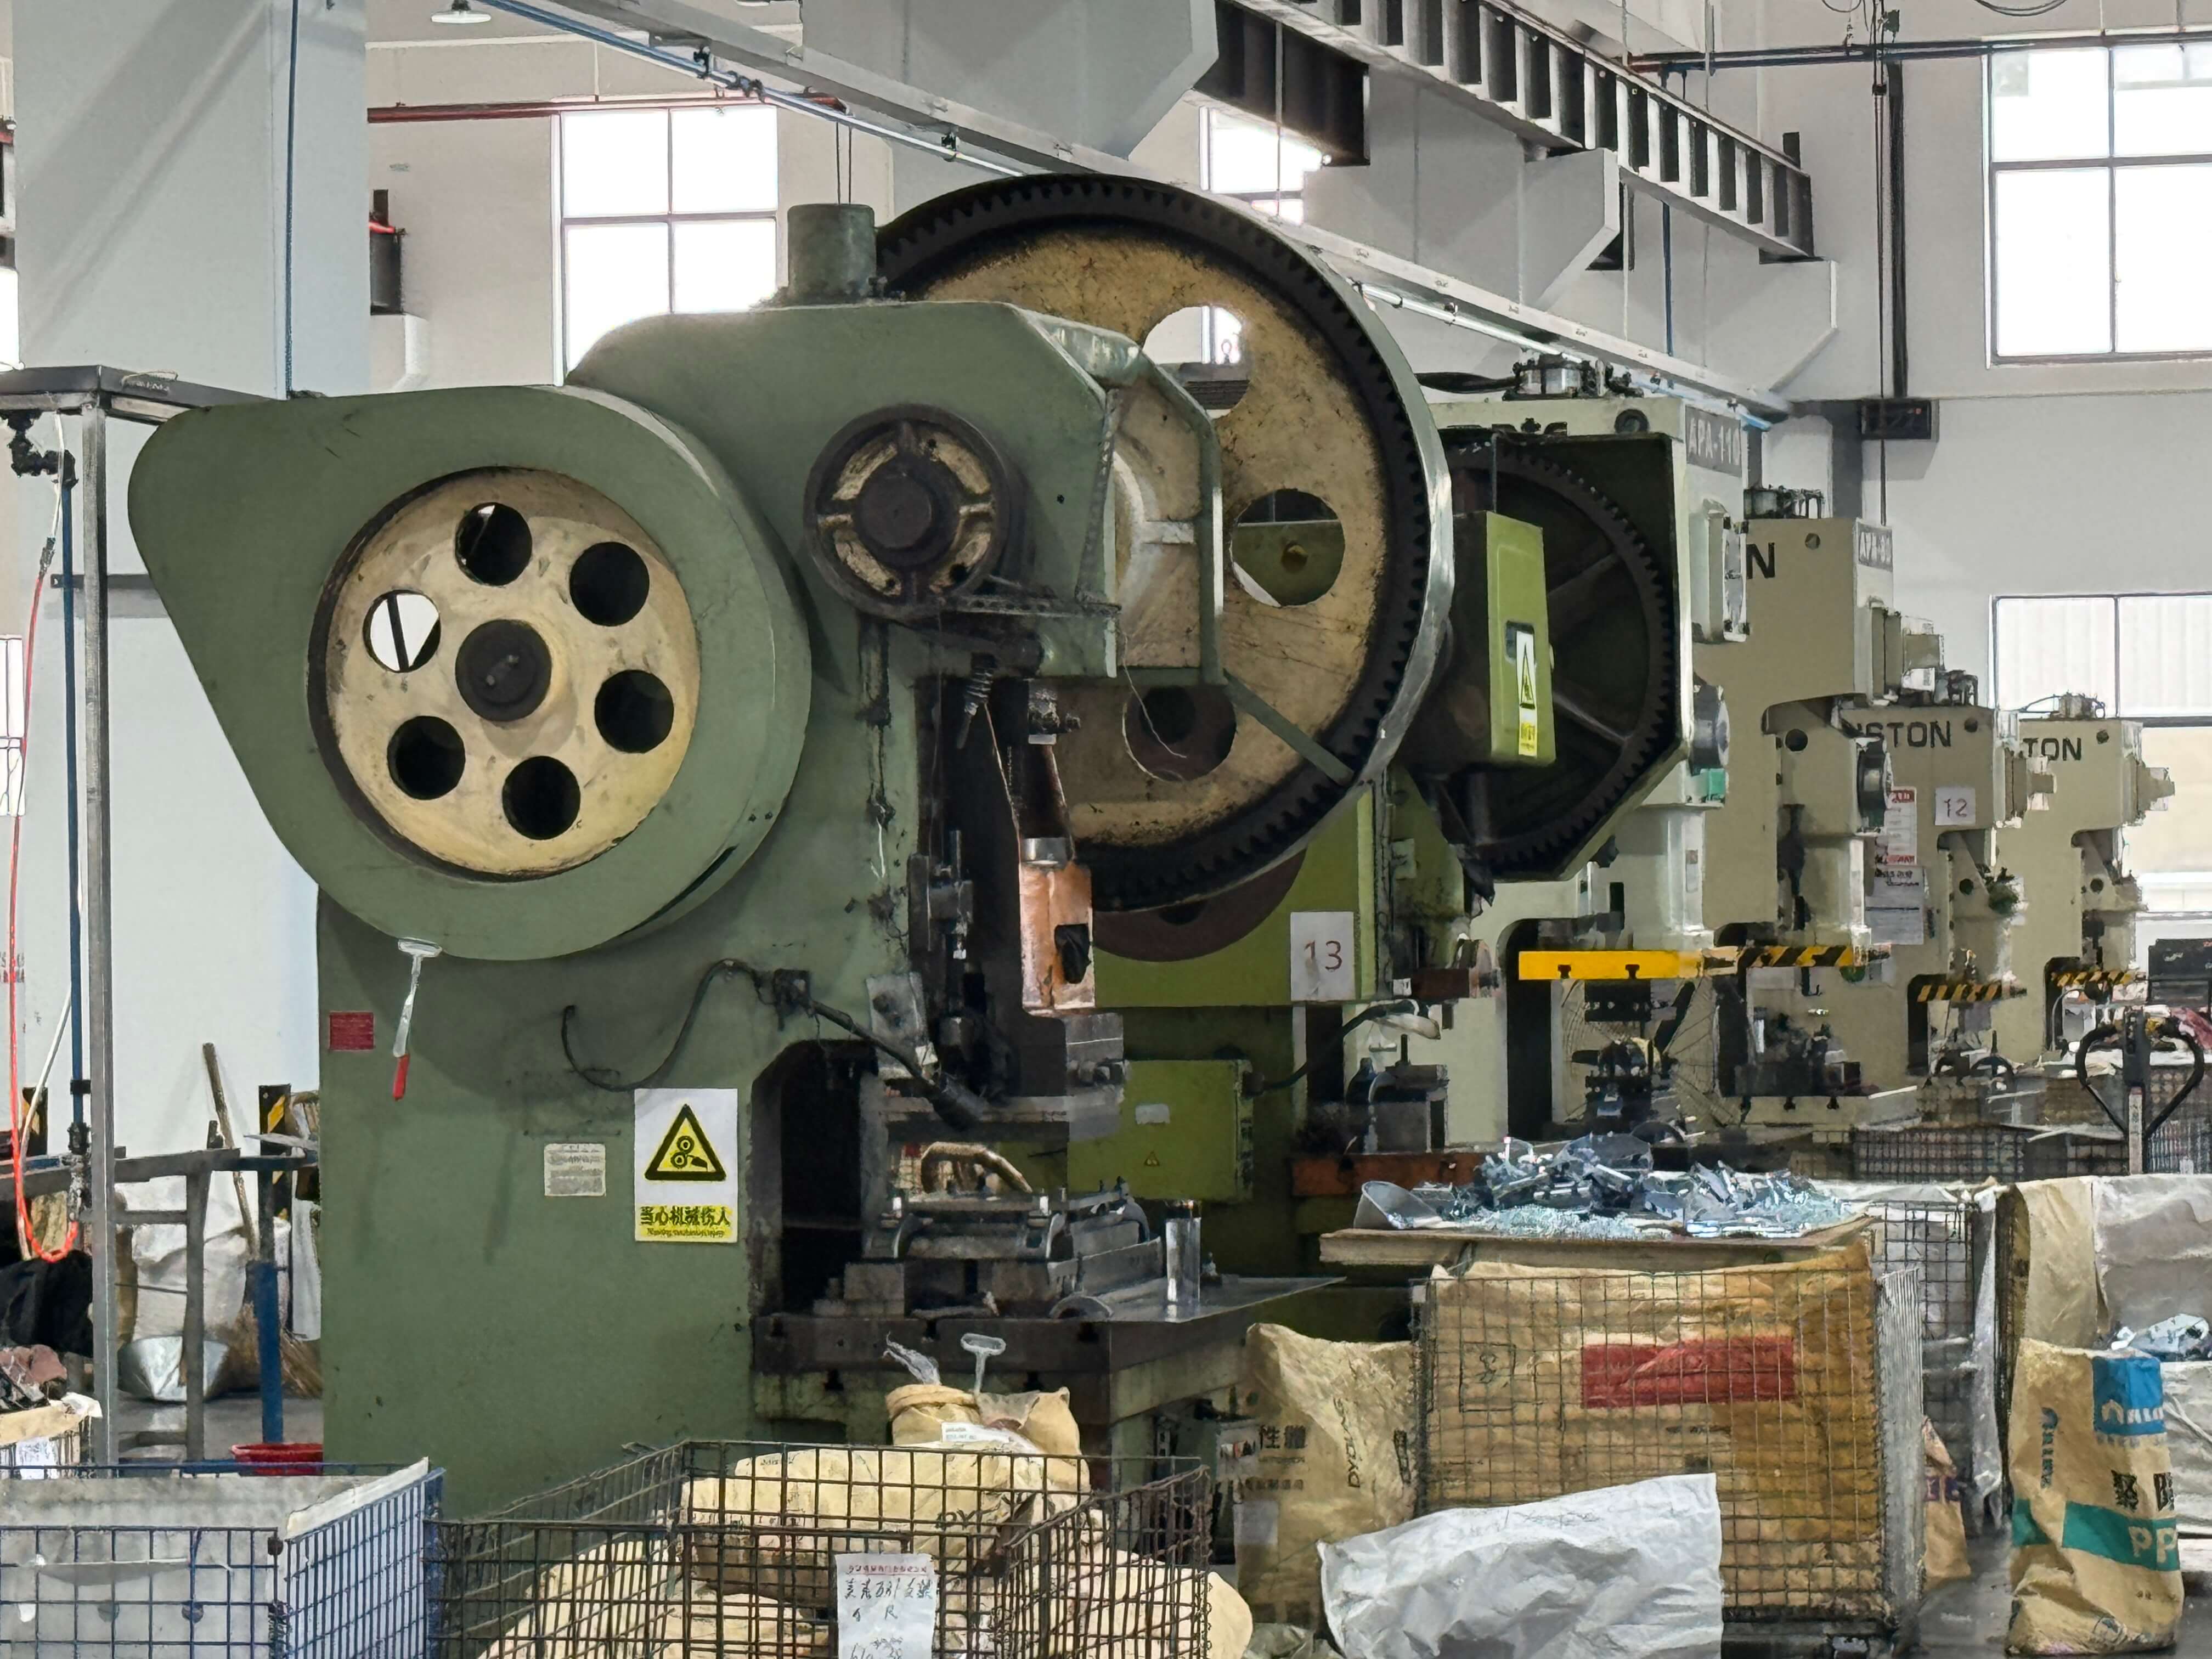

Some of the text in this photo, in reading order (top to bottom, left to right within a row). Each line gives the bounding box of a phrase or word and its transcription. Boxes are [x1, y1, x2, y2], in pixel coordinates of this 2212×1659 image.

[1857, 720, 1951, 748] STON
[2021, 737, 2082, 761] TON
[1944, 798, 1968, 819] 12
[1304, 940, 1344, 972] 13
